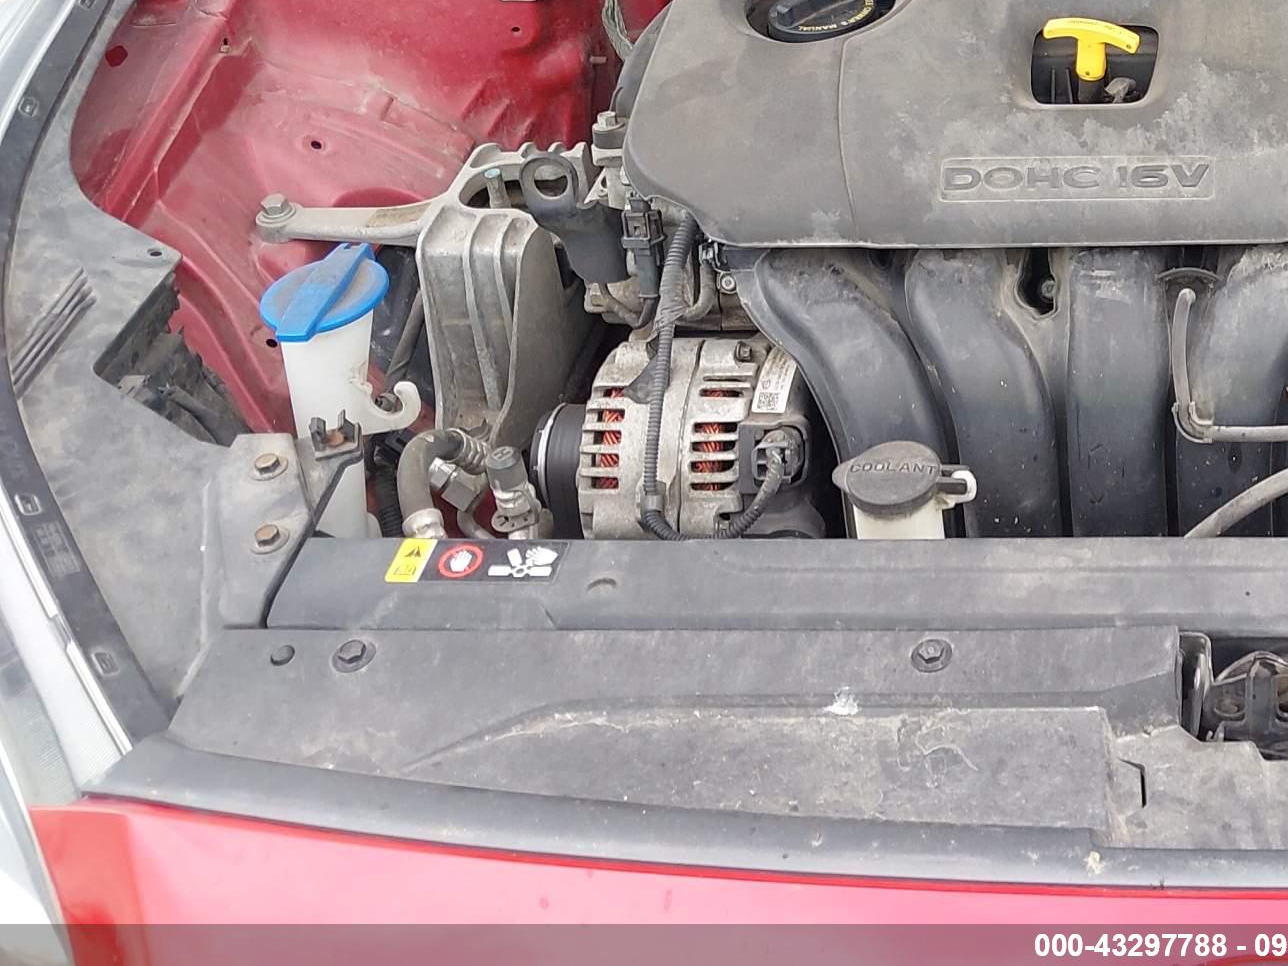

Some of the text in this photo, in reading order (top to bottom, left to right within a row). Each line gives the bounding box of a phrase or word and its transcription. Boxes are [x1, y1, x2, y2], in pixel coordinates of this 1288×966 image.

[943, 163, 1210, 191] DOHC 16V
[849, 461, 938, 475] COOLANT
